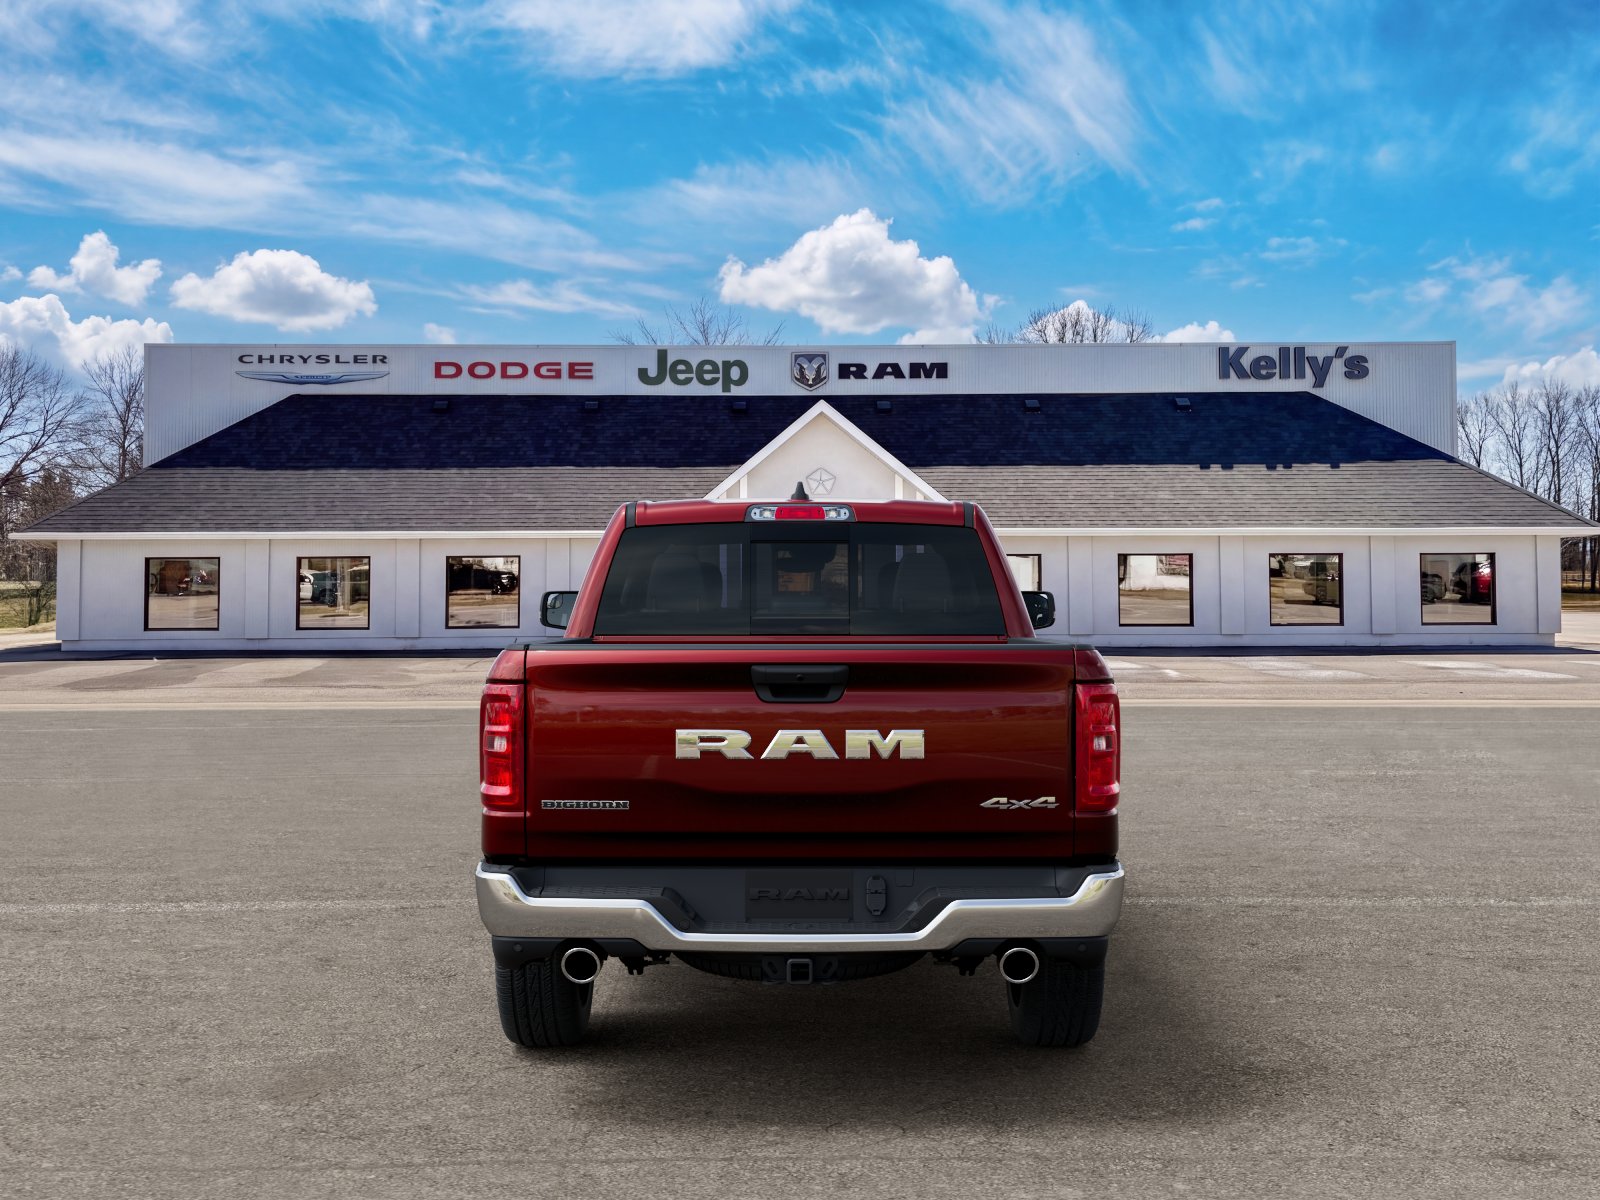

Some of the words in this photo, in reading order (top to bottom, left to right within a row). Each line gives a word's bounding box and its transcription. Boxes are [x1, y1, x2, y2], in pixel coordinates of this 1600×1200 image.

[238, 354, 388, 364] CHRYSLER
[1219, 346, 1370, 388] Kelly's
[434, 362, 594, 379] DODGE
[637, 349, 749, 393] Jeep
[838, 362, 948, 379] RAM
[675, 729, 925, 760] RAM
[541, 800, 630, 810] BIGHORN
[980, 796, 1060, 809] 4x4
[749, 887, 850, 901] RAM
